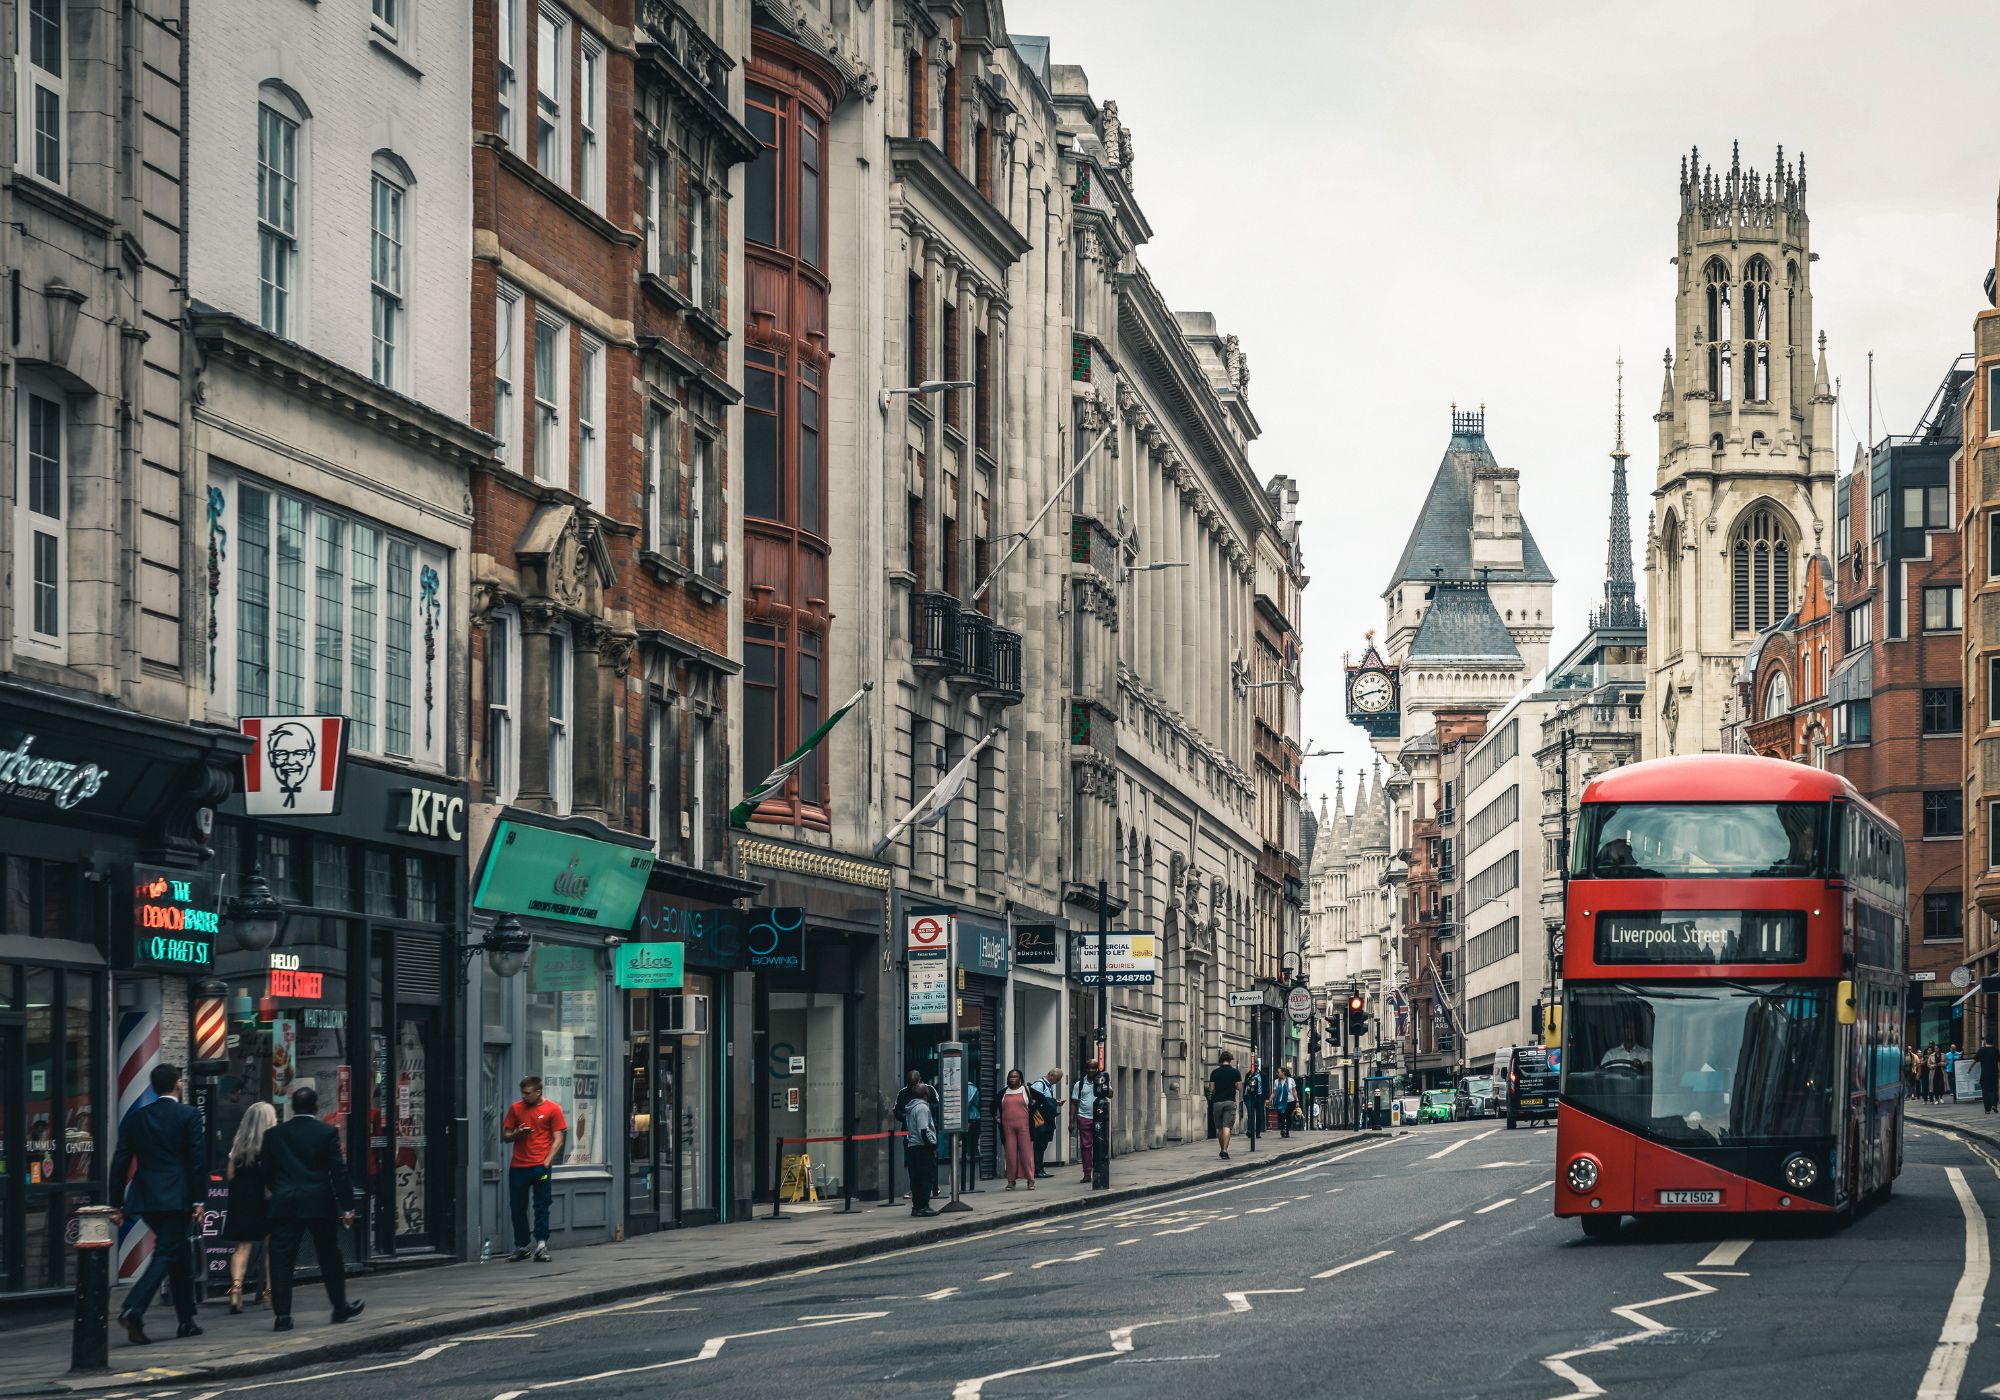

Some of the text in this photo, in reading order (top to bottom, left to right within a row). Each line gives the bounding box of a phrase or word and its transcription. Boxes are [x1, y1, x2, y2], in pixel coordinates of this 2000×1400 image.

[408, 787, 464, 841] KFC
[170, 881, 192, 902] THE
[143, 904, 219, 933] DEMON BARBER
[663, 905, 703, 938] BOWING
[151, 936, 167, 959] OF
[168, 939, 195, 961] FLEET
[1611, 922, 1782, 951] Liverpool Street 11
[271, 954, 299, 971] HELLO
[629, 947, 673, 970] elias
[752, 956, 798, 965] BOWING
[982, 936, 1005, 968] Hudgell
[1132, 949, 1153, 957] savills
[271, 969, 294, 997] FLEET
[1116, 974, 1152, 982] 248780
[1667, 1192, 1714, 1203] LTZ 1502
